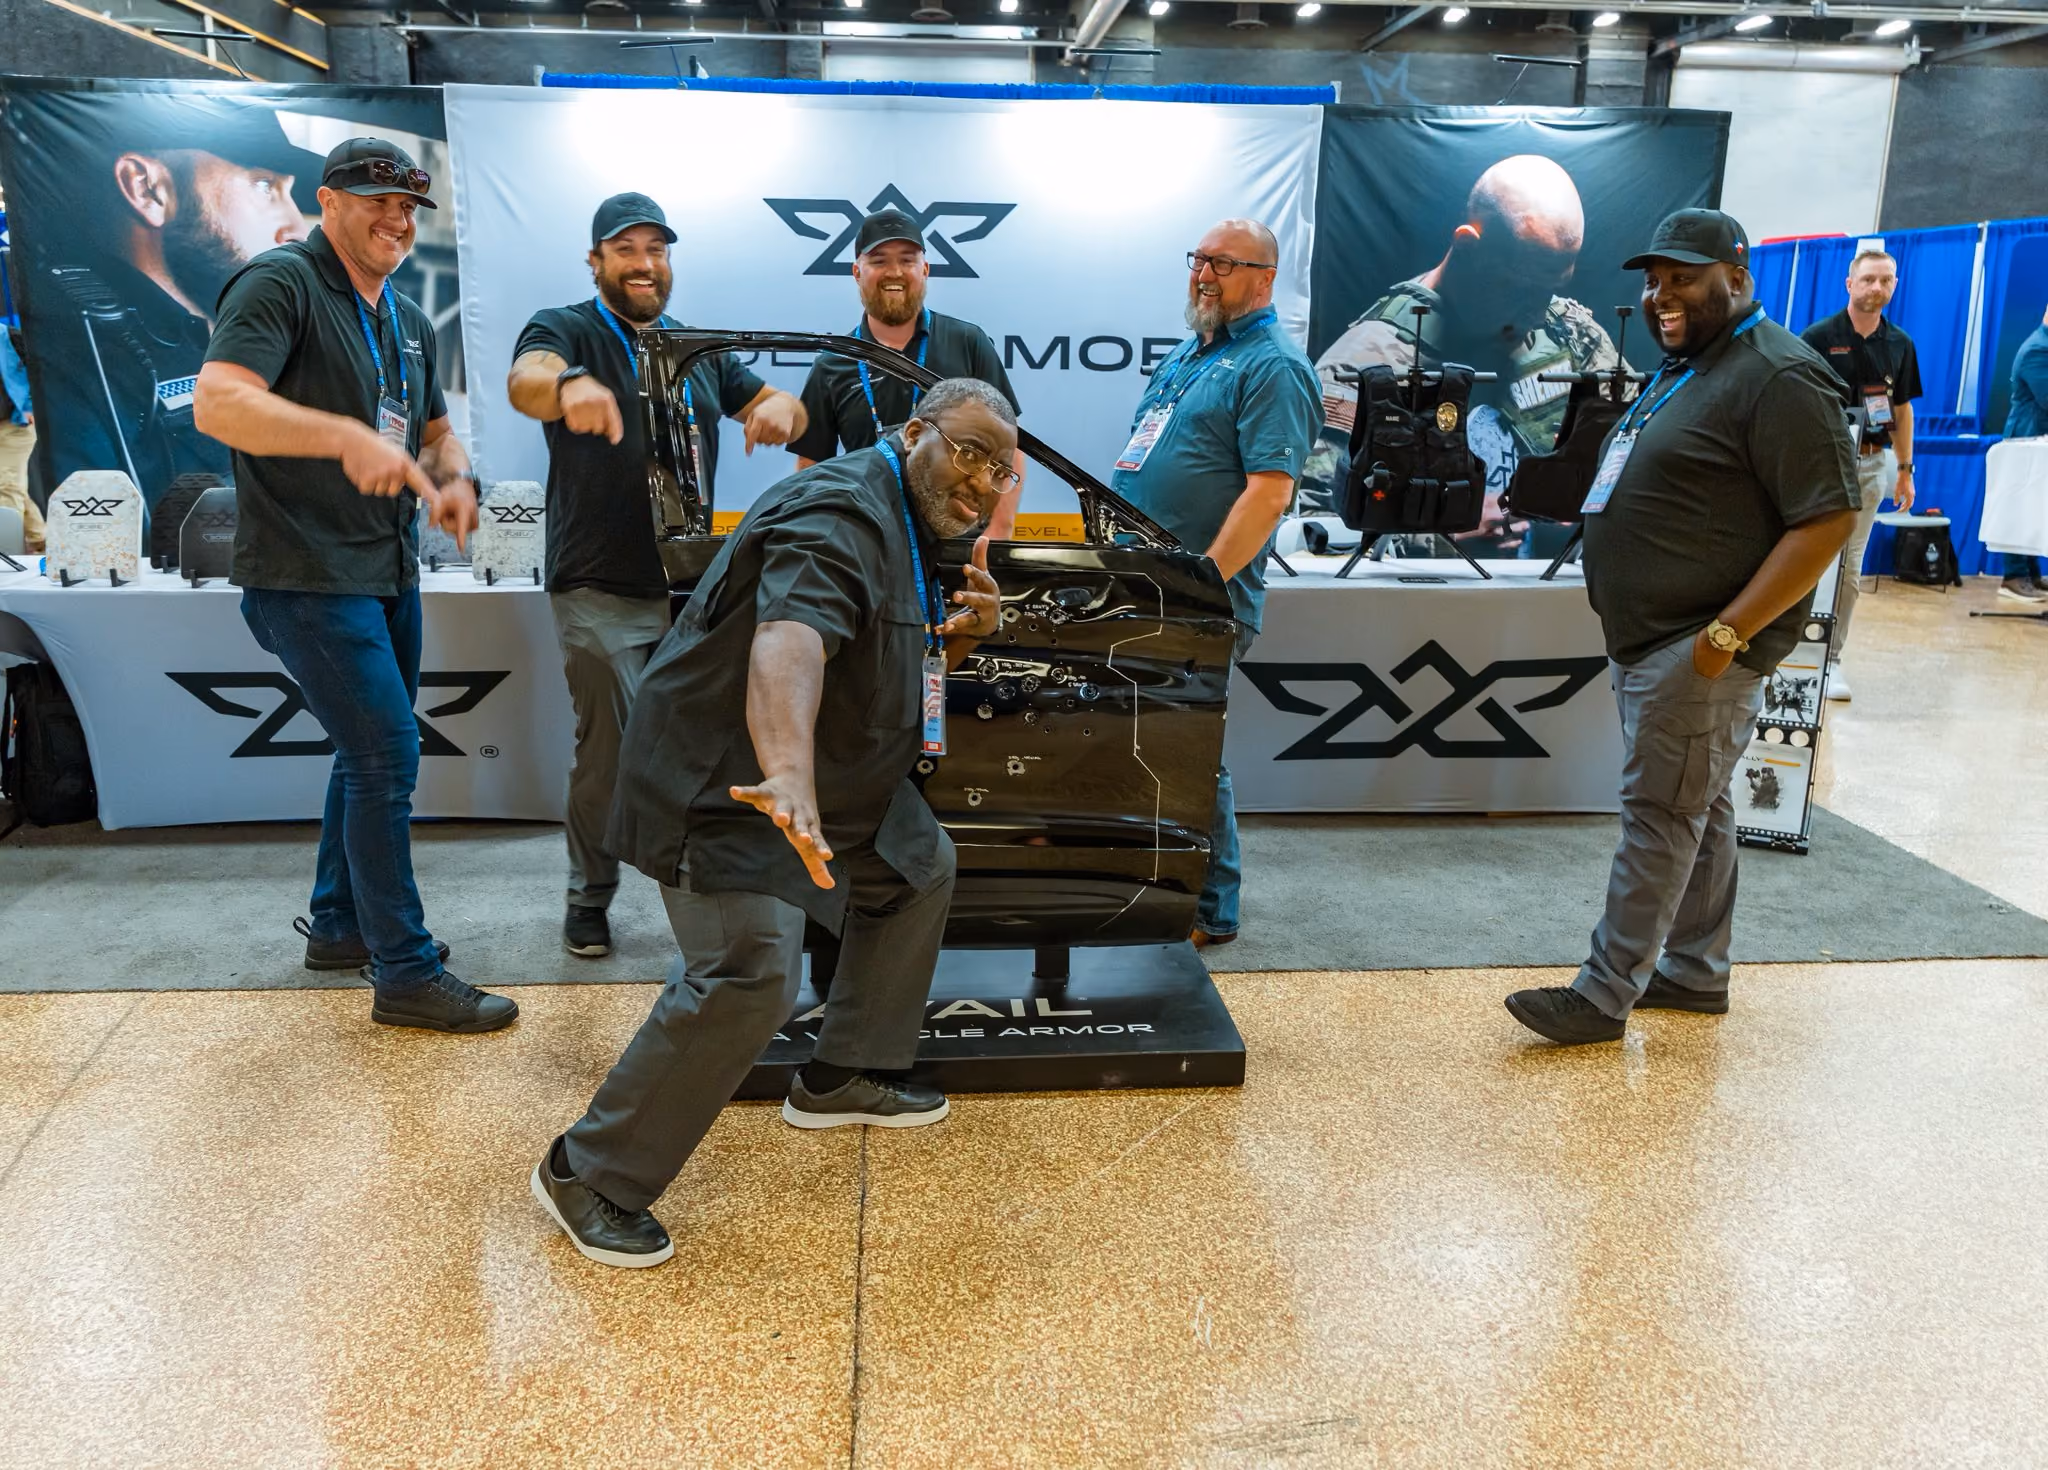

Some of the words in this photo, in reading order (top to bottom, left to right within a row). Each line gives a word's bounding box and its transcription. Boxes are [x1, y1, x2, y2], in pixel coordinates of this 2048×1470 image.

[1004, 335, 1185, 371] MOR
[1014, 526, 1070, 537] EVEL
[998, 1023, 1156, 1037] ARMOR
